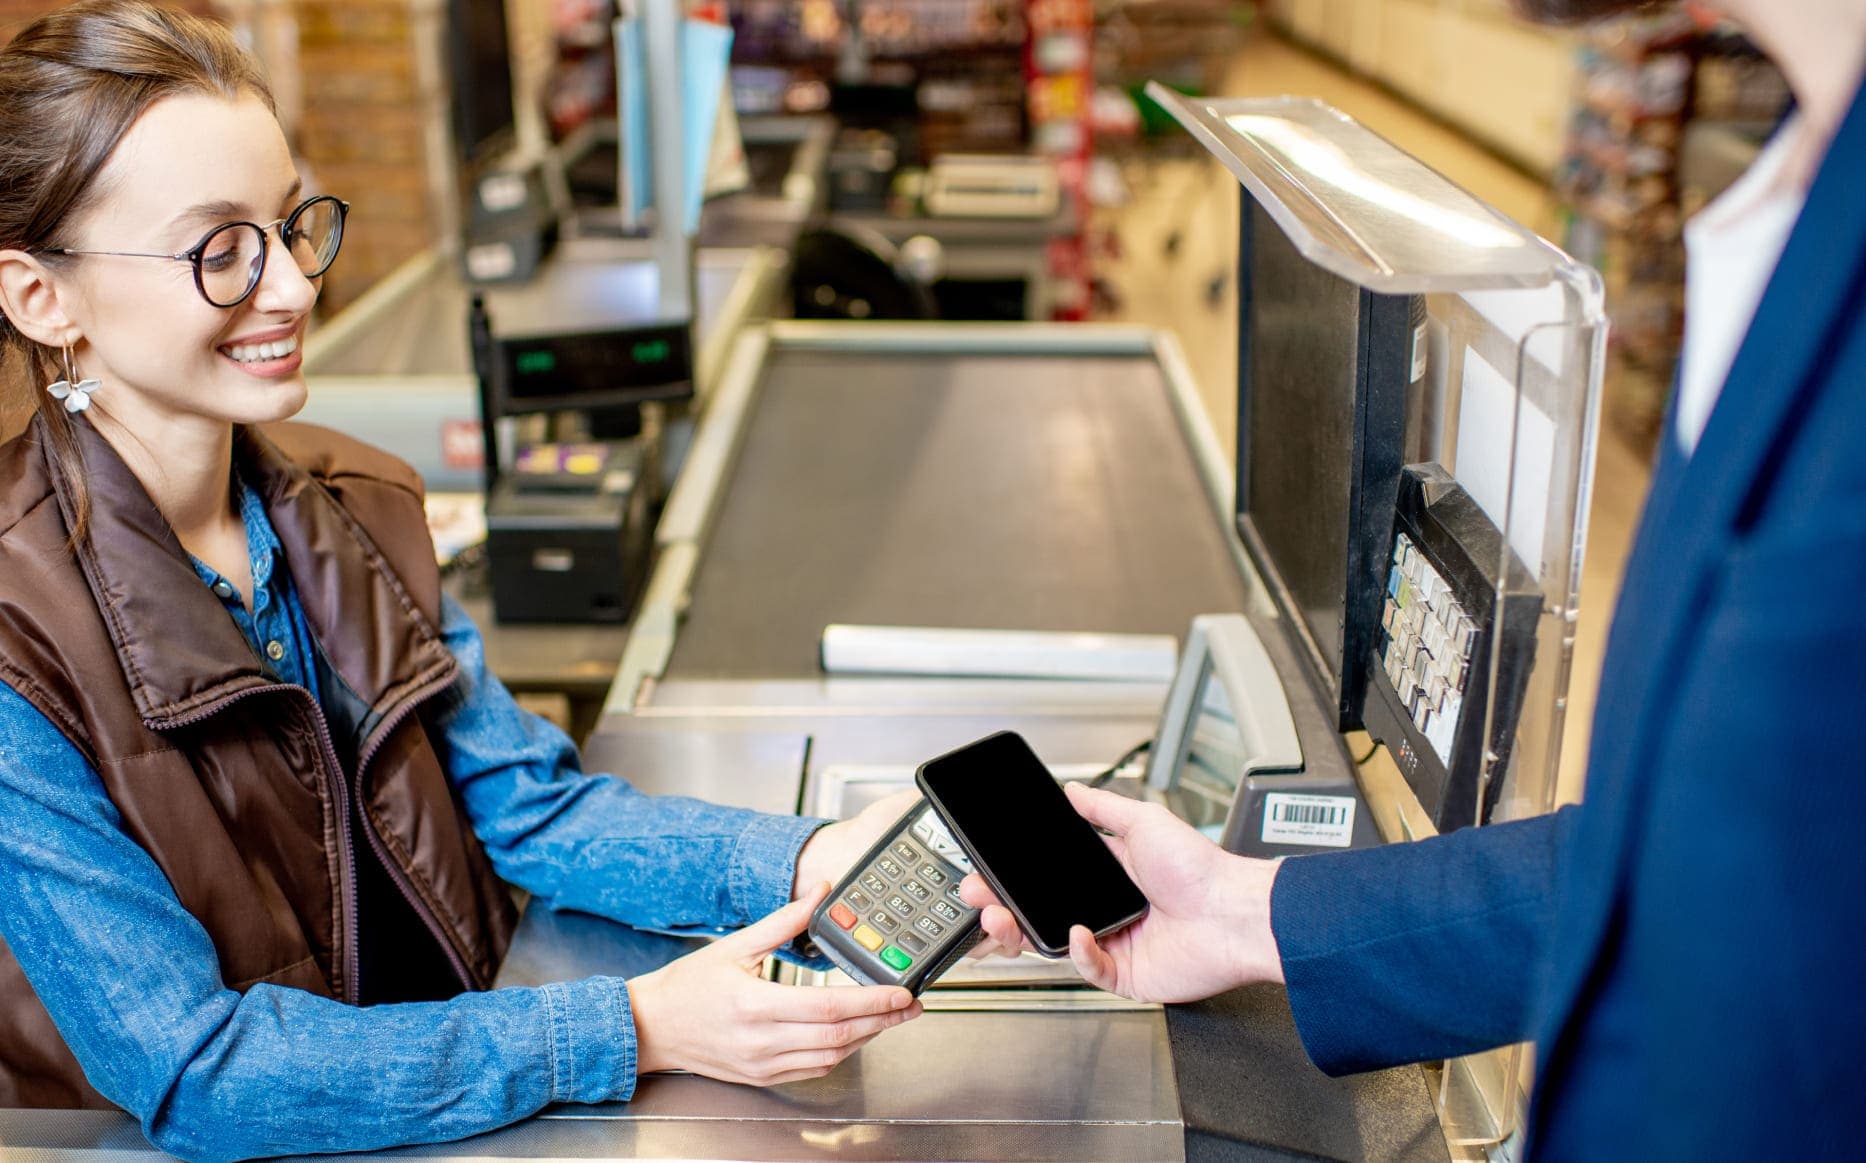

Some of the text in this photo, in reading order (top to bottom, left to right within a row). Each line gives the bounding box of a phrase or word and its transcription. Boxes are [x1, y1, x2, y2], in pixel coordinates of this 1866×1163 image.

[881, 861, 891, 869] 4
[923, 866, 934, 876] 2
[866, 875, 877, 884] 7
[907, 881, 918, 891] 5
[891, 897, 902, 906] 8
[936, 902, 947, 911] 6
[920, 918, 931, 928] 9
